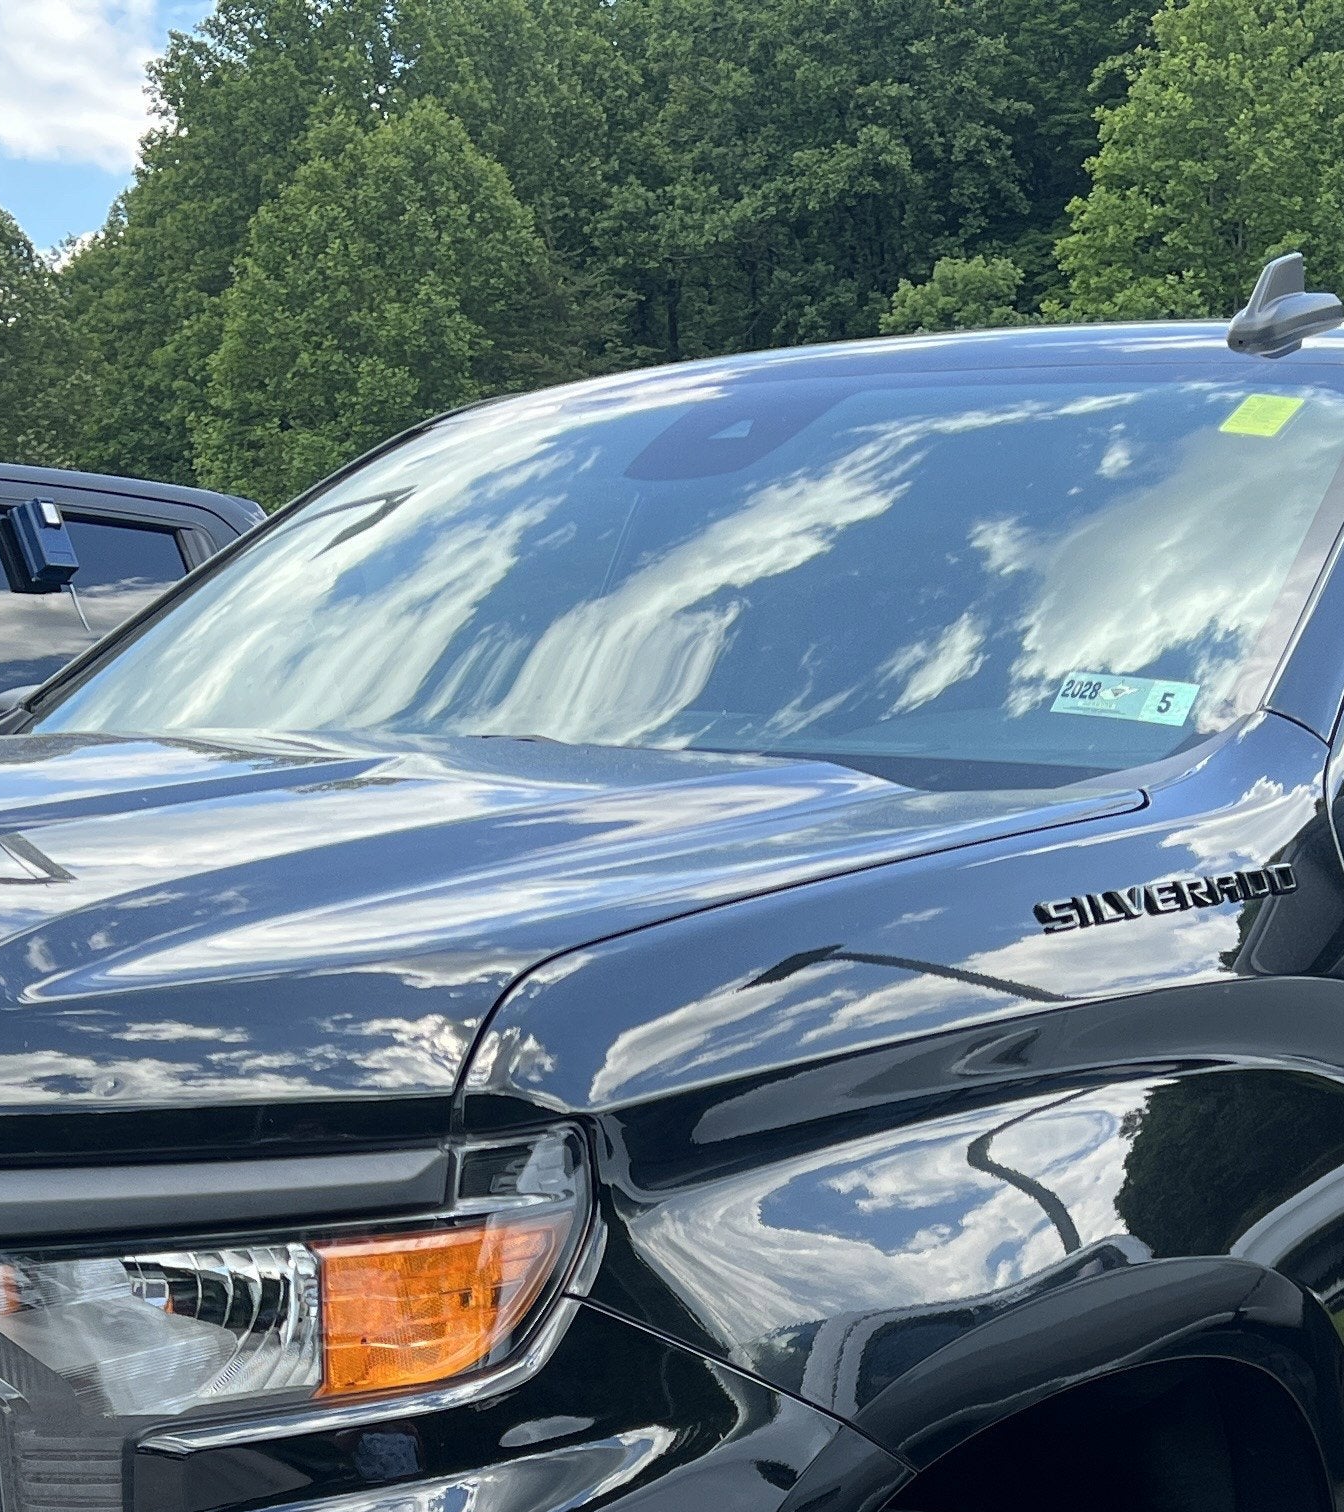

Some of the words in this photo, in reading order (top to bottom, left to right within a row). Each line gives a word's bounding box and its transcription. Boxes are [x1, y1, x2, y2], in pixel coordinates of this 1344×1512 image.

[1060, 680, 1103, 701] 2028
[1157, 693, 1175, 714] 5
[1033, 863, 1298, 934] SILVERADO
